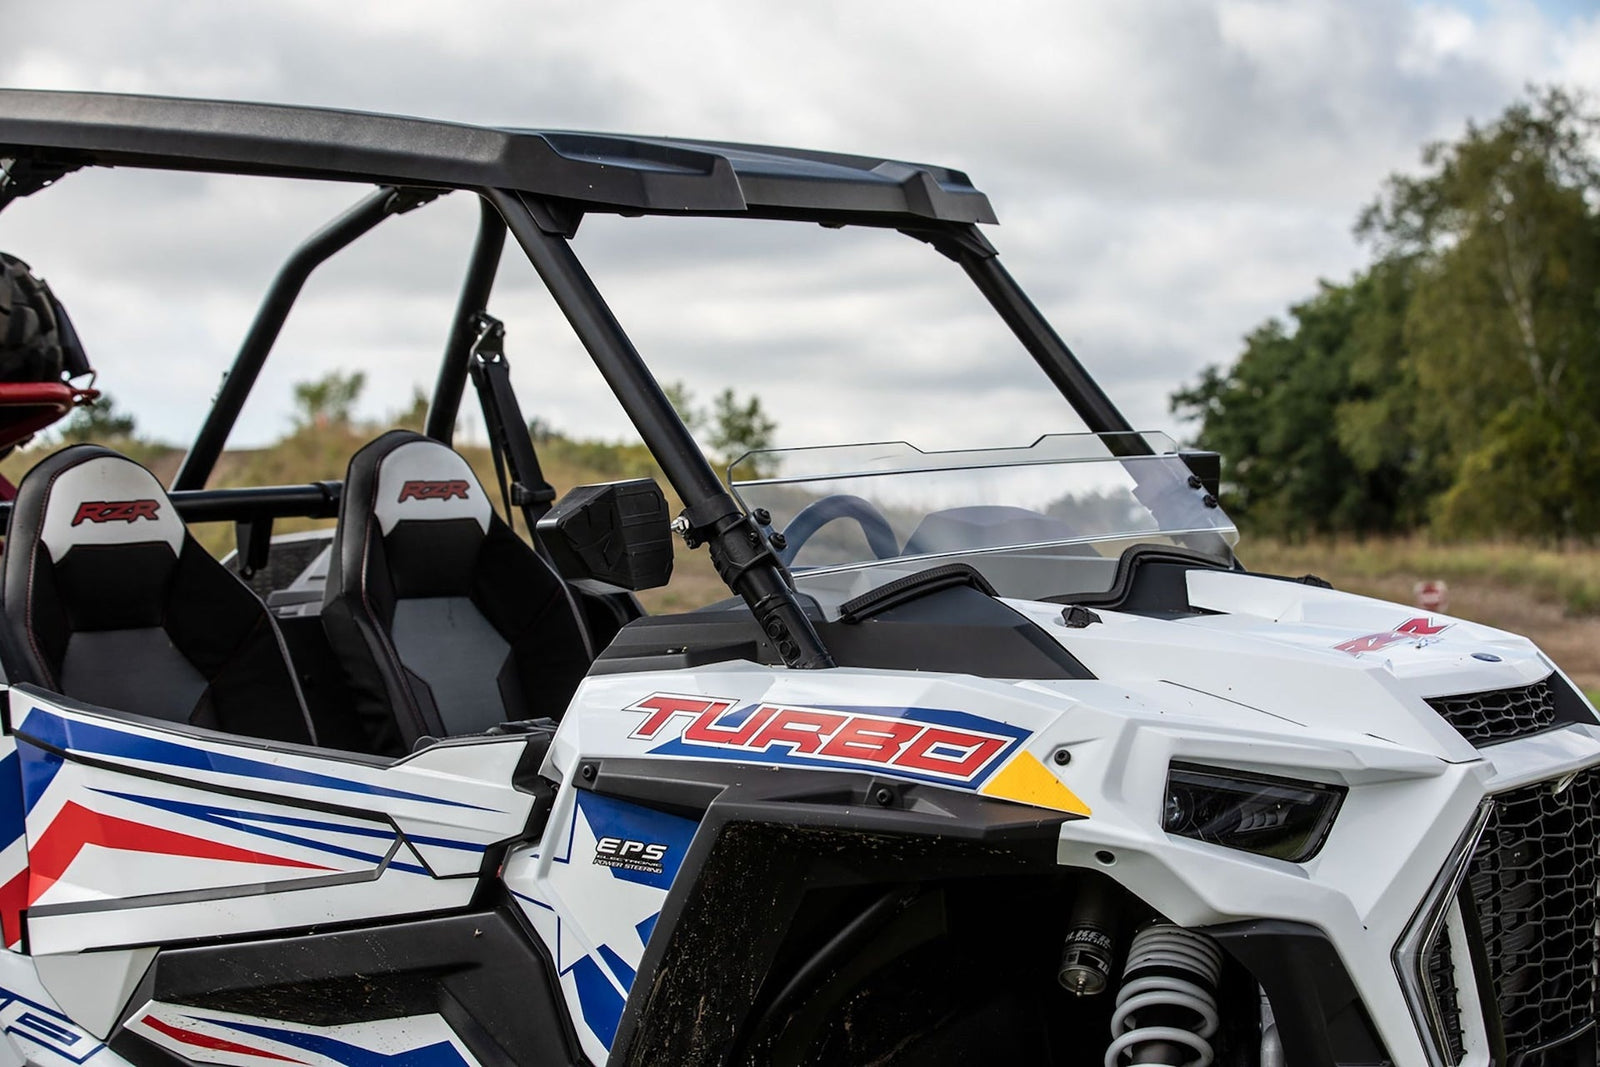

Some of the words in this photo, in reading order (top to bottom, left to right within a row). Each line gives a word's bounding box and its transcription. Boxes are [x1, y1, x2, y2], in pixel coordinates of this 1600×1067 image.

[398, 480, 470, 504] RZR
[71, 499, 161, 526] RZR
[624, 692, 1016, 780] TURBO
[596, 837, 668, 861] EPS
[593, 859, 623, 869] POWER
[623, 863, 663, 874] STEERING
